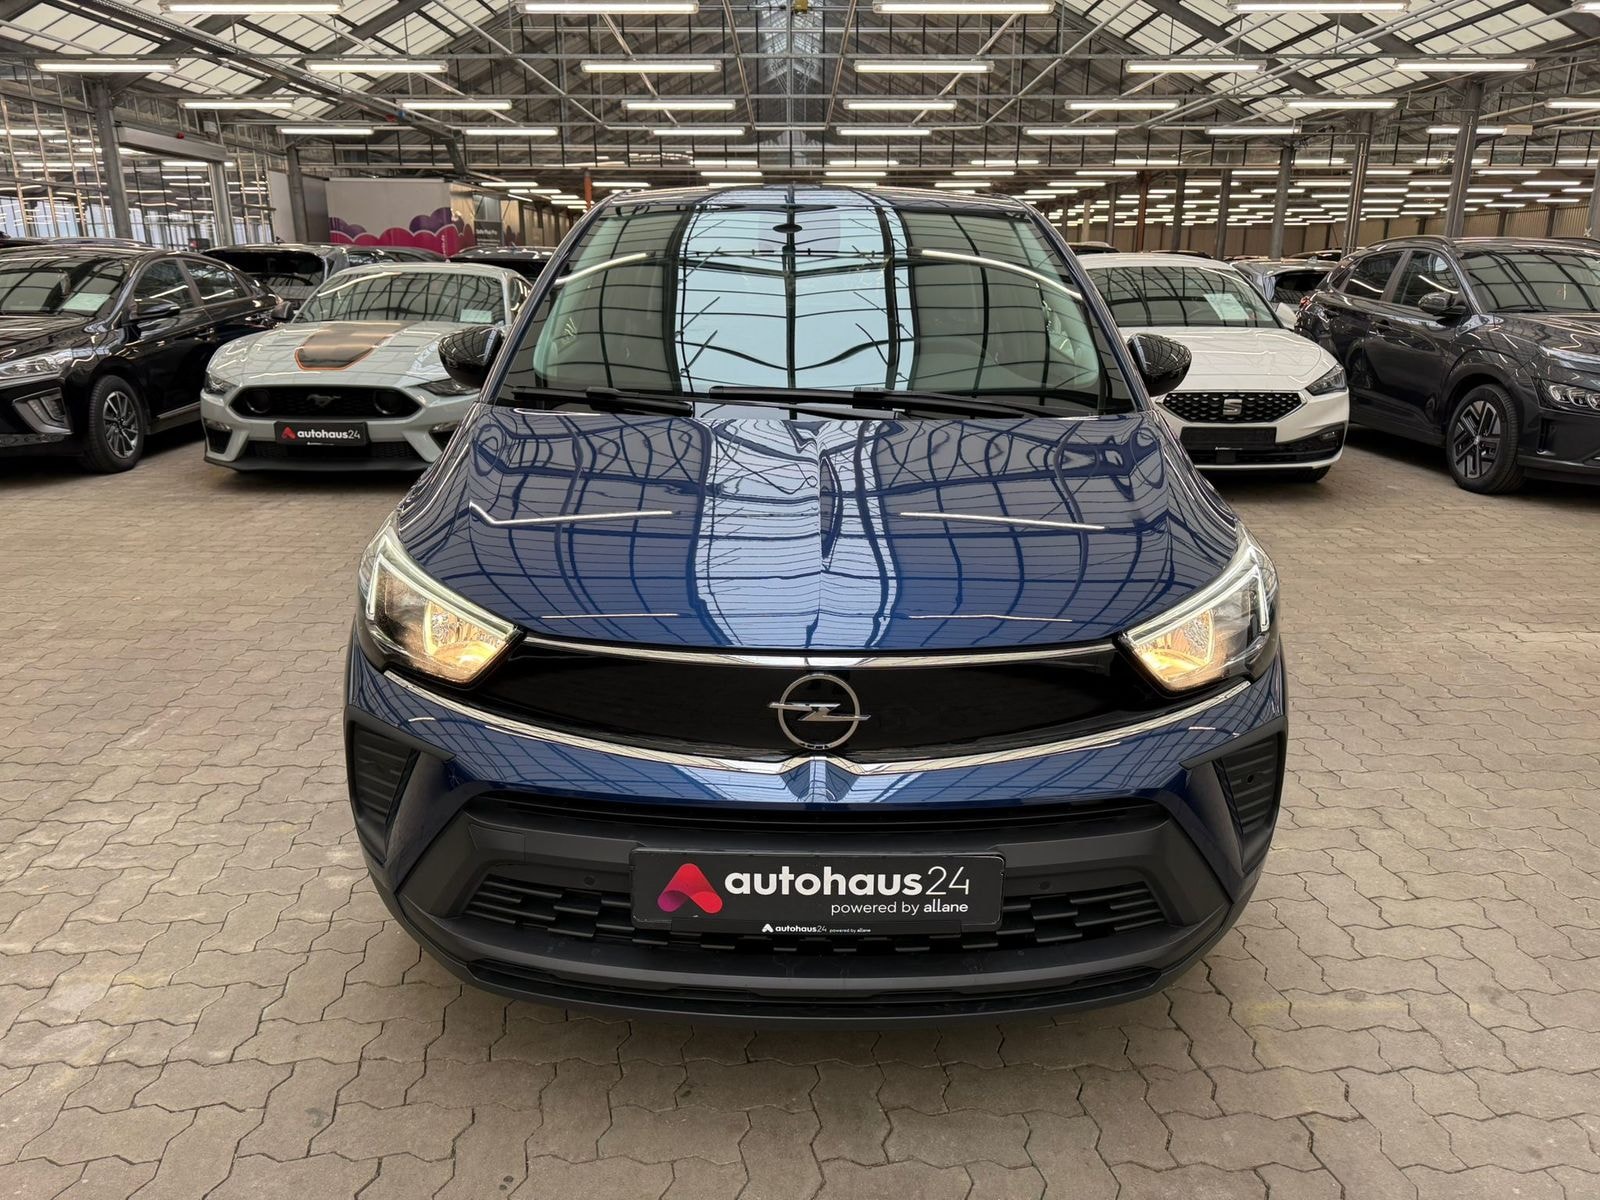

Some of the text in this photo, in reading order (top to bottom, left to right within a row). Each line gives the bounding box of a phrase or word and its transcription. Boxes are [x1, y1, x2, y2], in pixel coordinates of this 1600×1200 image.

[297, 429, 360, 439] autohaus24
[723, 865, 970, 896] autohaus24
[831, 899, 969, 917] powered by allane
[775, 925, 827, 933] autohaus24
